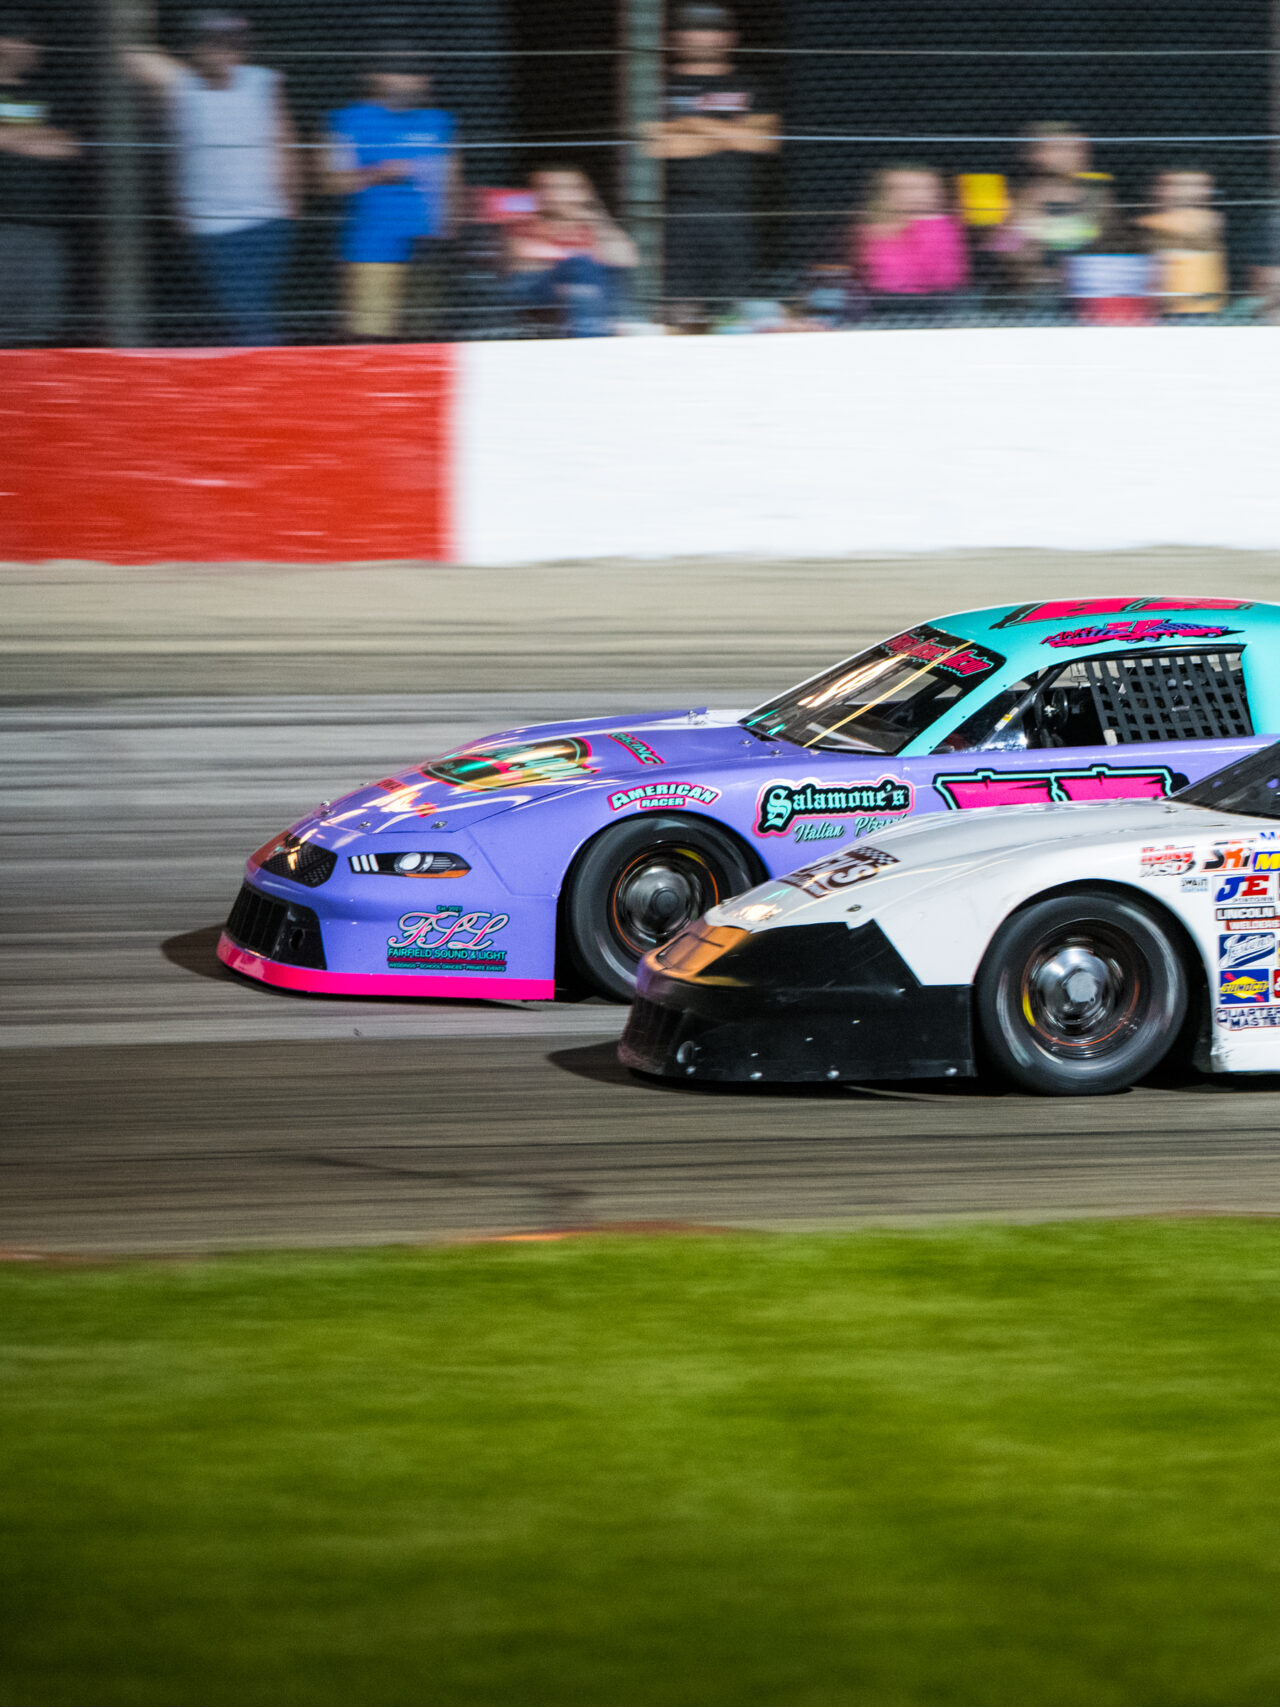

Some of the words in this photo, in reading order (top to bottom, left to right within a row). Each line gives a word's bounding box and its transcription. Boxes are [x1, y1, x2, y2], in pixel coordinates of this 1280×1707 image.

[611, 783, 718, 810] AMERICAN
[641, 797, 685, 808] RACER
[763, 783, 906, 828] Salamone's
[793, 821, 845, 843] Italian
[1216, 875, 1270, 902] JE
[1217, 906, 1275, 919] LINCOLN
[388, 948, 432, 958] FAIRFIELD
[434, 949, 468, 959] SOUND
[471, 951, 477, 960] &
[479, 951, 506, 961] LIGHT
